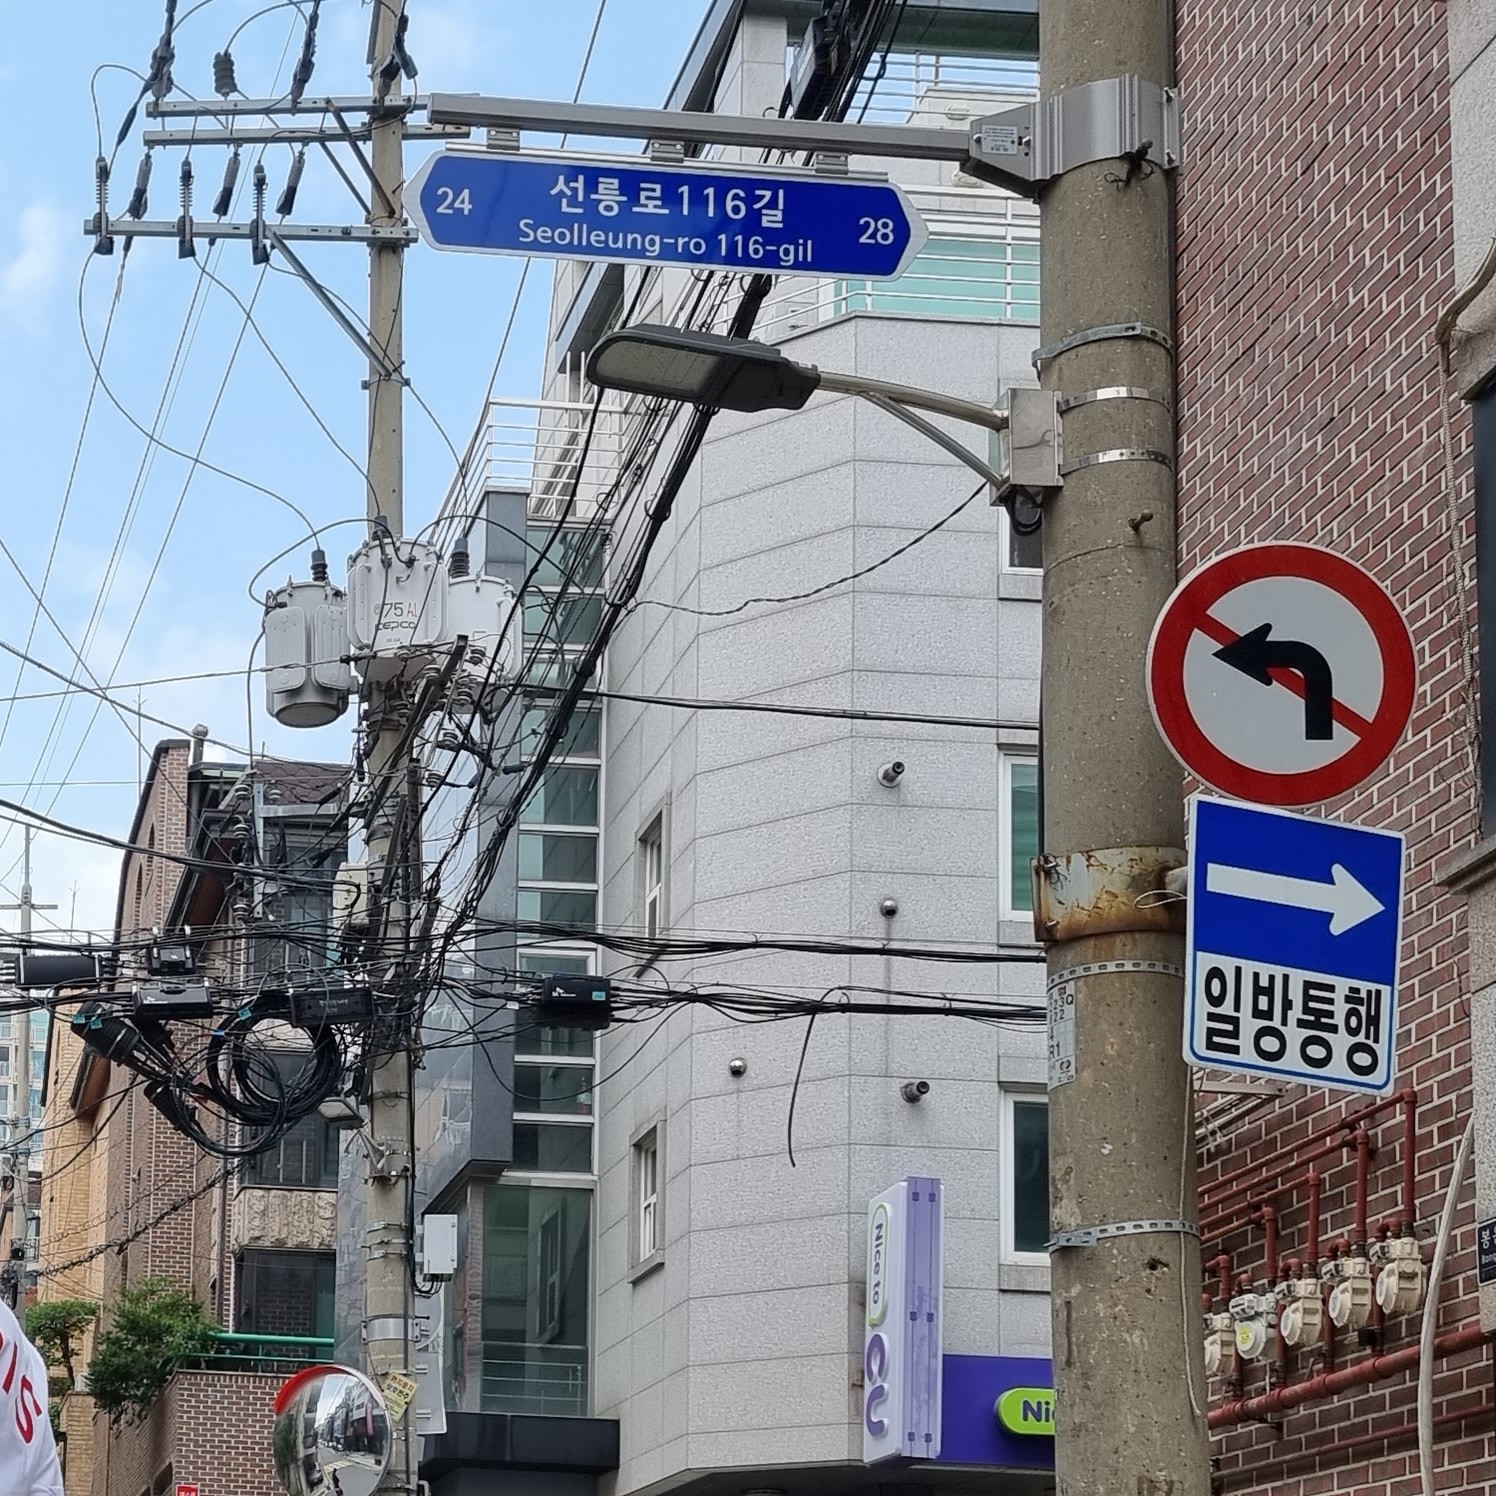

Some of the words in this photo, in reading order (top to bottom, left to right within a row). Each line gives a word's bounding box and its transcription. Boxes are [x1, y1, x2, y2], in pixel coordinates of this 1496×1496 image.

[436, 188, 473, 215] 24
[549, 176, 785, 229] 선릉로116길
[518, 219, 707, 257] Seolleung-ro
[718, 234, 814, 266] 116-gil
[858, 217, 895, 246] 28
[1205, 965, 1382, 1077] 일방통행
[875, 1222, 884, 1276] Nice
[873, 1280, 881, 1305] to
[1022, 1398, 1055, 1423] Ni
